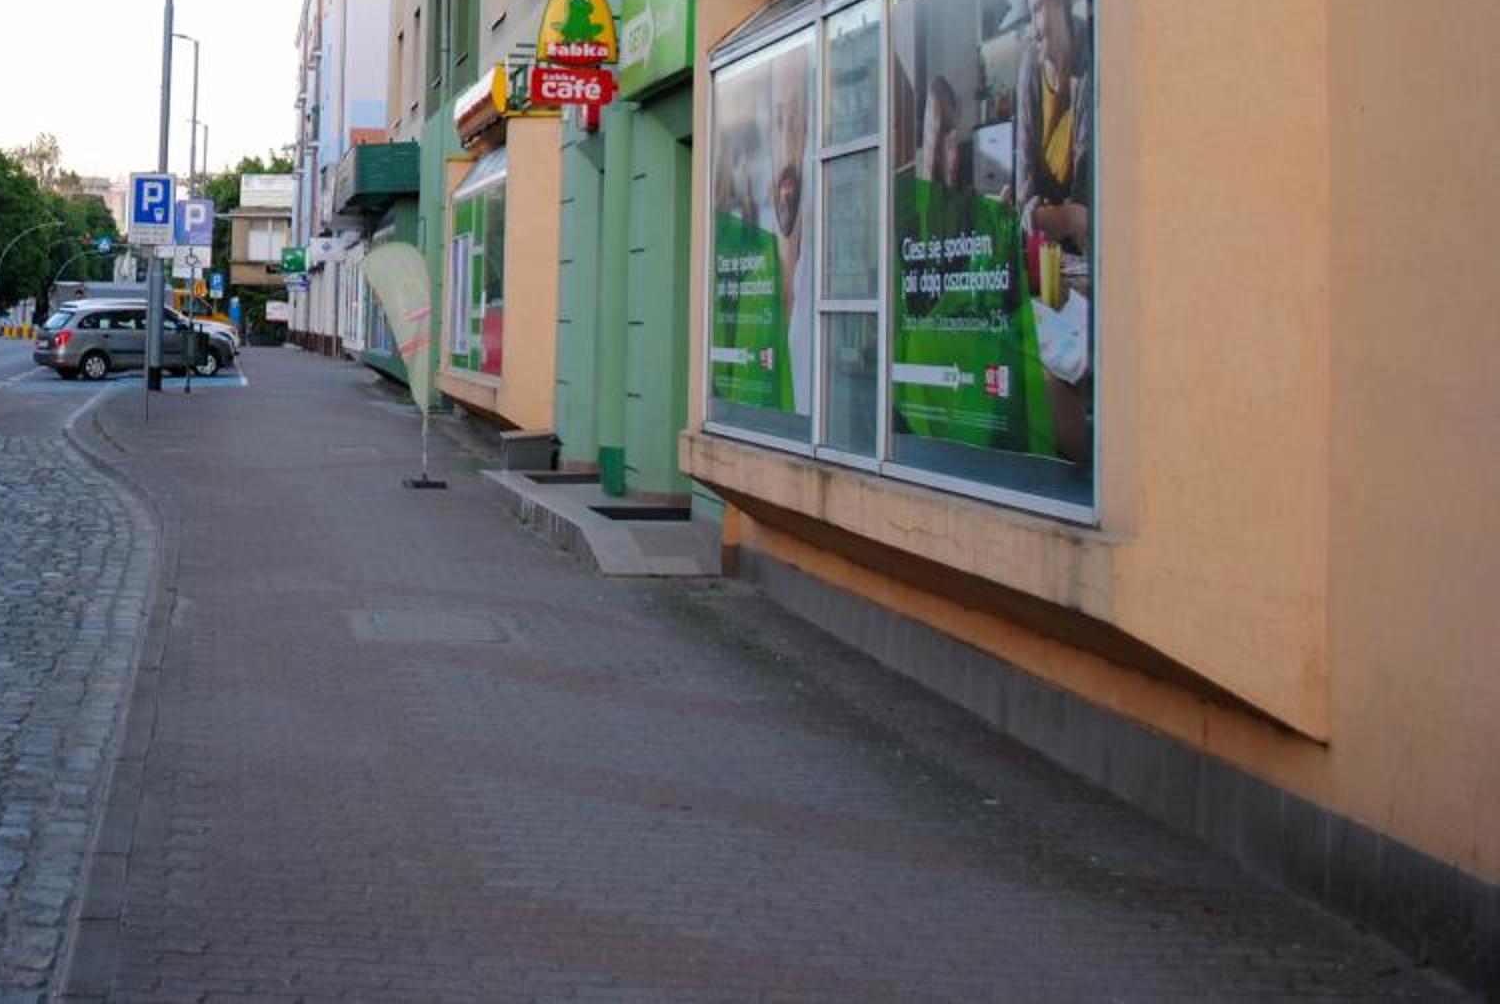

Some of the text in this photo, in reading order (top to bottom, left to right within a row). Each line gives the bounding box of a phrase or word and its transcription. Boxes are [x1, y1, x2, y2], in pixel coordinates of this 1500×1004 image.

[541, 77, 602, 101] café
[141, 181, 164, 212] P
[185, 203, 206, 232] P
